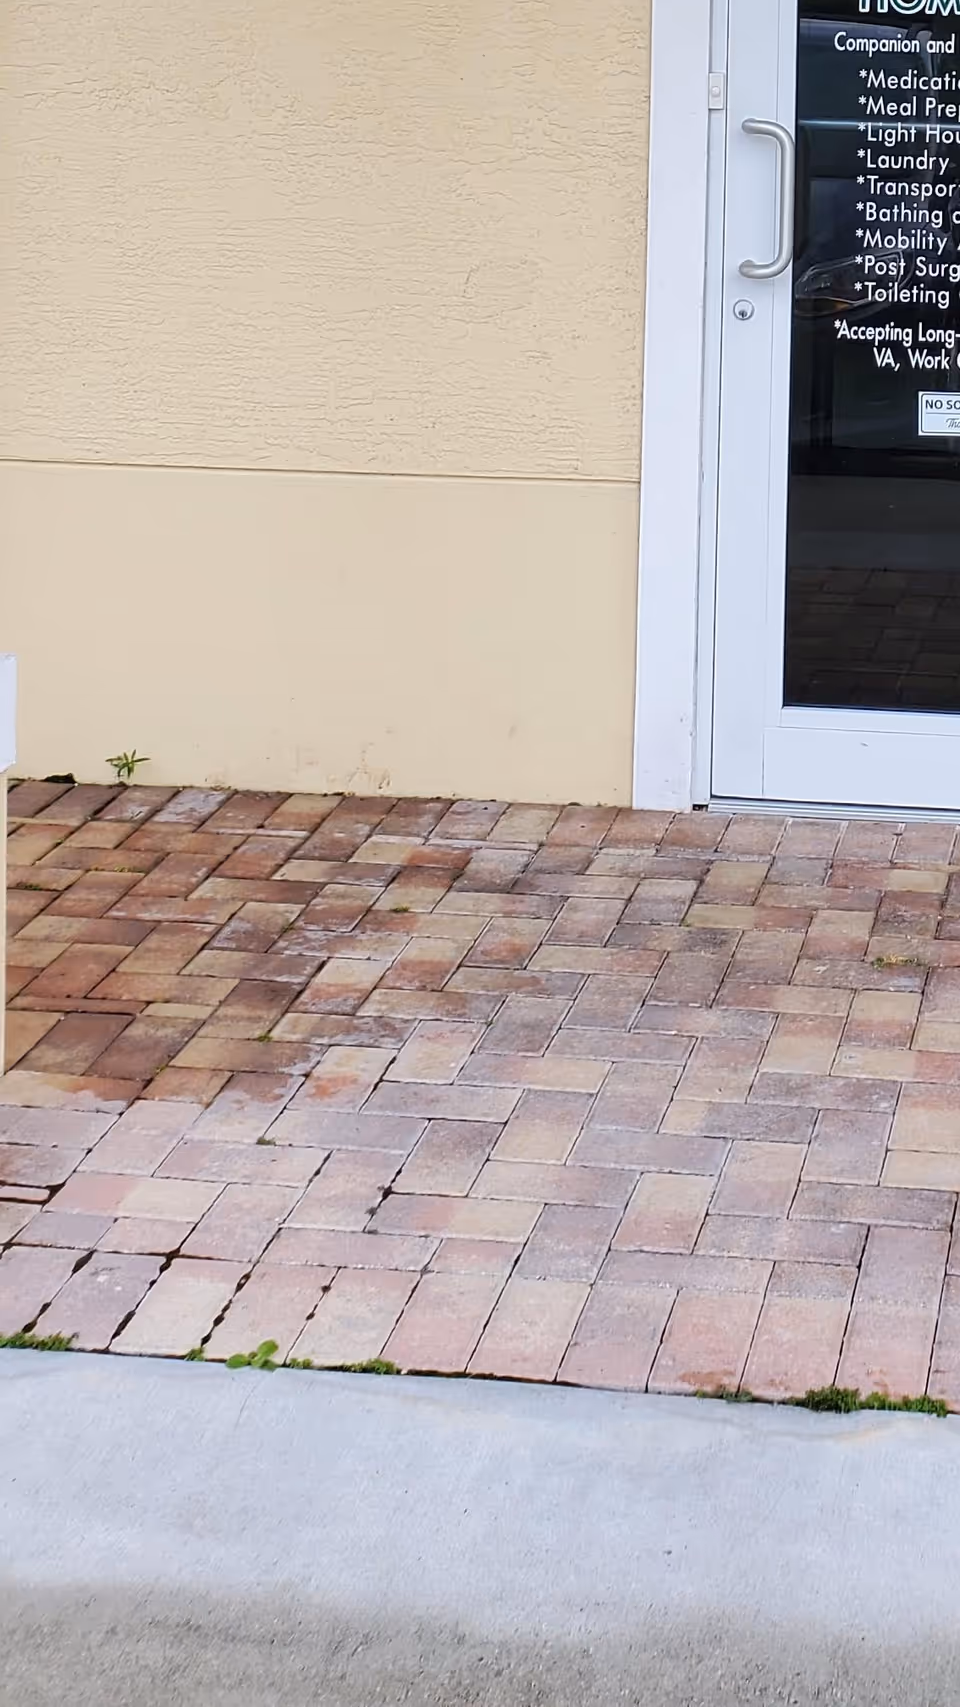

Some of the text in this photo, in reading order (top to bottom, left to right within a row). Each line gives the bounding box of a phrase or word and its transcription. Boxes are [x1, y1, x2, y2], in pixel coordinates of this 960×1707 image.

[834, 32, 920, 57] Companion
[926, 35, 955, 54] and
[873, 347, 901, 372] VA,
[909, 350, 950, 370] Work
[925, 399, 943, 411] NO
